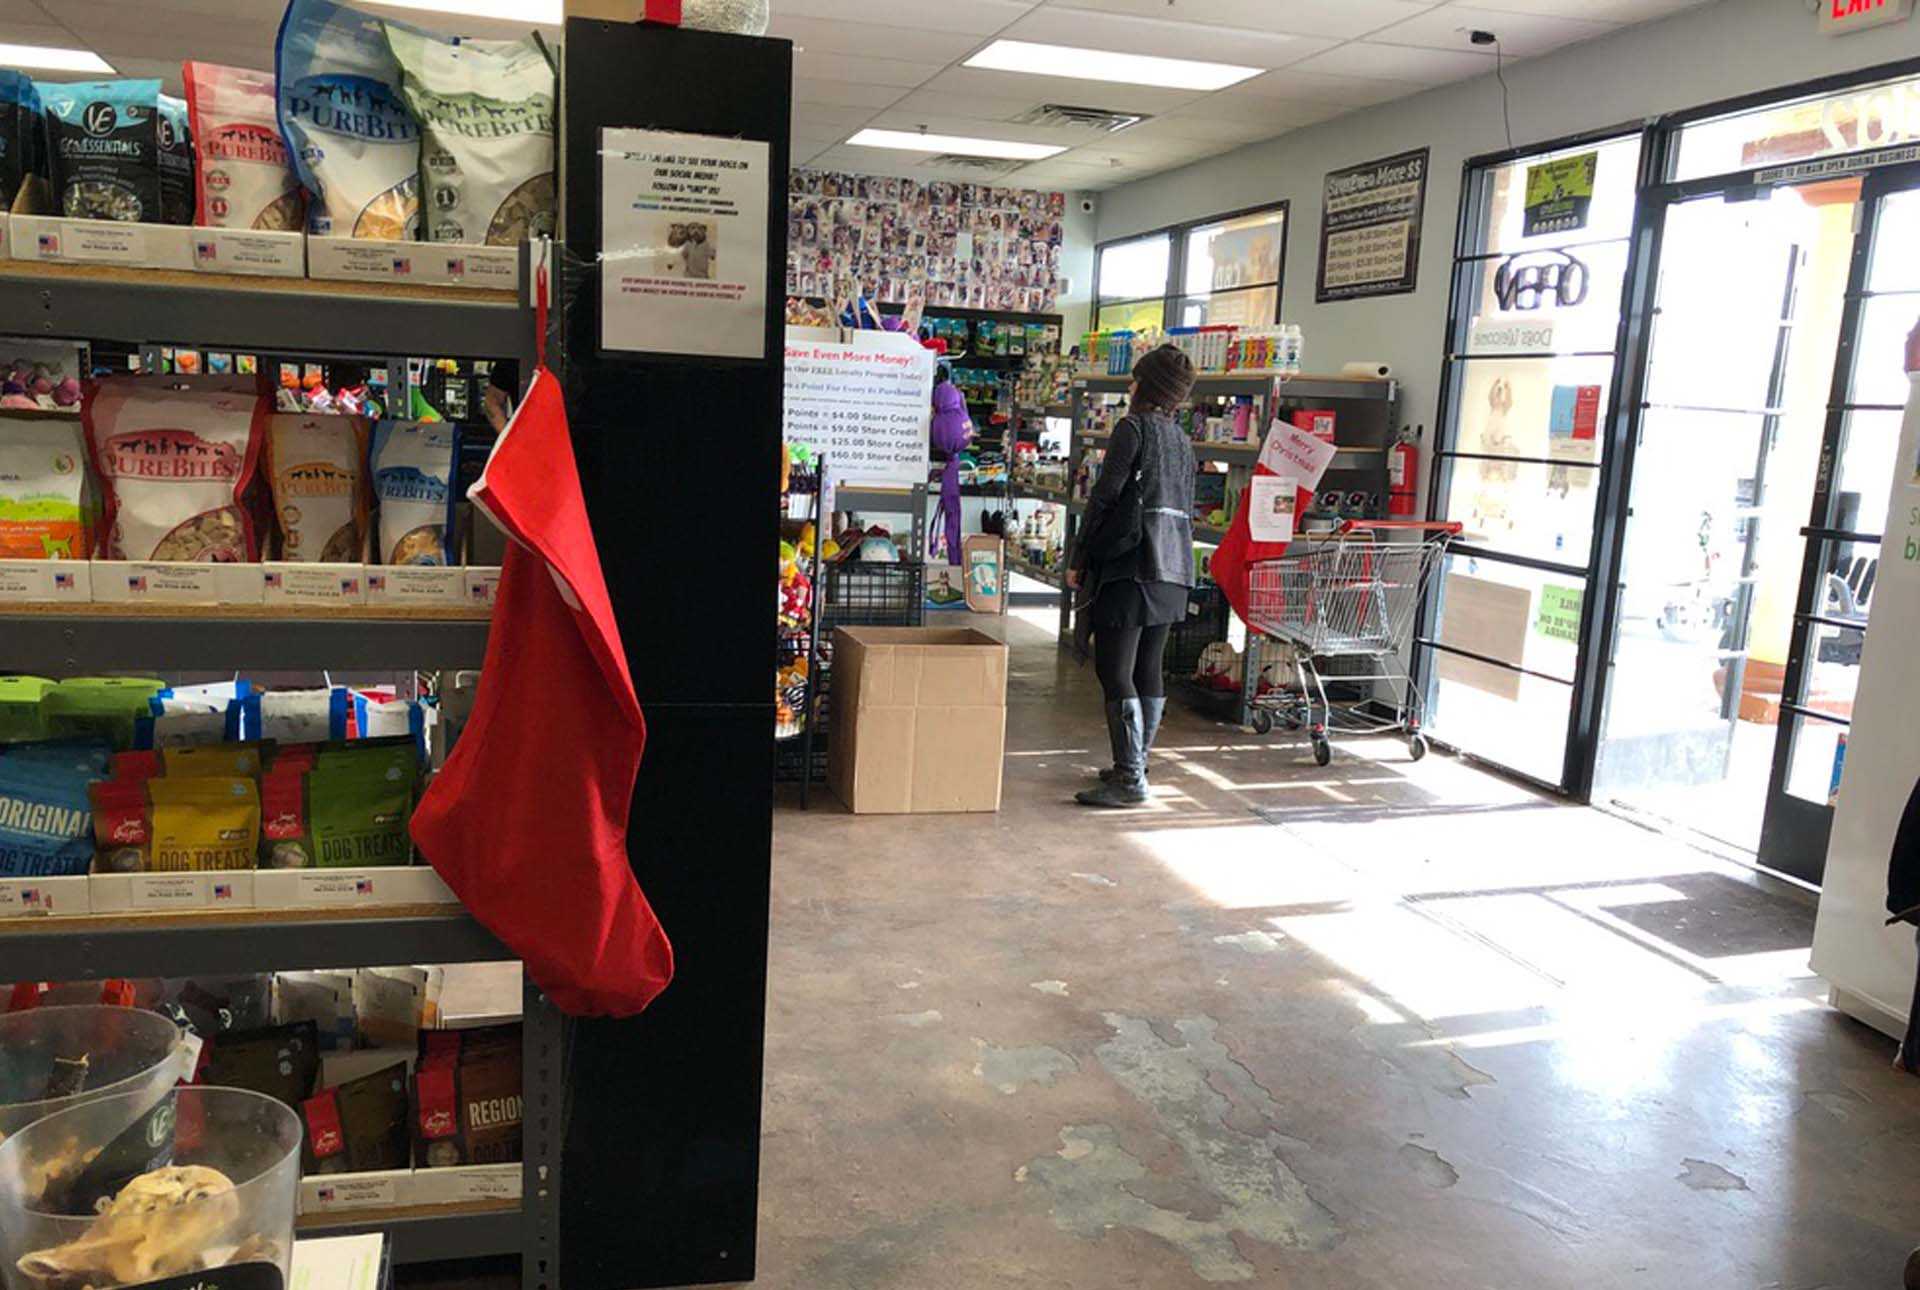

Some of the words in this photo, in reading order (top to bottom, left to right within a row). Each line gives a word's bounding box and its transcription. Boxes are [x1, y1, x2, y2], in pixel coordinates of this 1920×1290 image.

[813, 348, 840, 360] Even
[842, 351, 871, 362] More
[787, 408, 819, 418] Points
[832, 410, 860, 420] $4.00
[862, 412, 888, 422] Store
[890, 413, 918, 424] Credit
[787, 421, 818, 431] Points
[831, 423, 859, 433] $9.00
[861, 425, 887, 435] Store
[889, 427, 918, 436] Credit
[831, 437, 865, 447] $25.00
[867, 438, 893, 448] Store
[895, 440, 923, 450] Credit
[867, 452, 892, 461] Store
[894, 453, 922, 463] Credit
[321, 837, 353, 862] DOG
[357, 833, 402, 859] TREATS
[159, 850, 190, 872] DOG
[195, 849, 250, 872] TREATS
